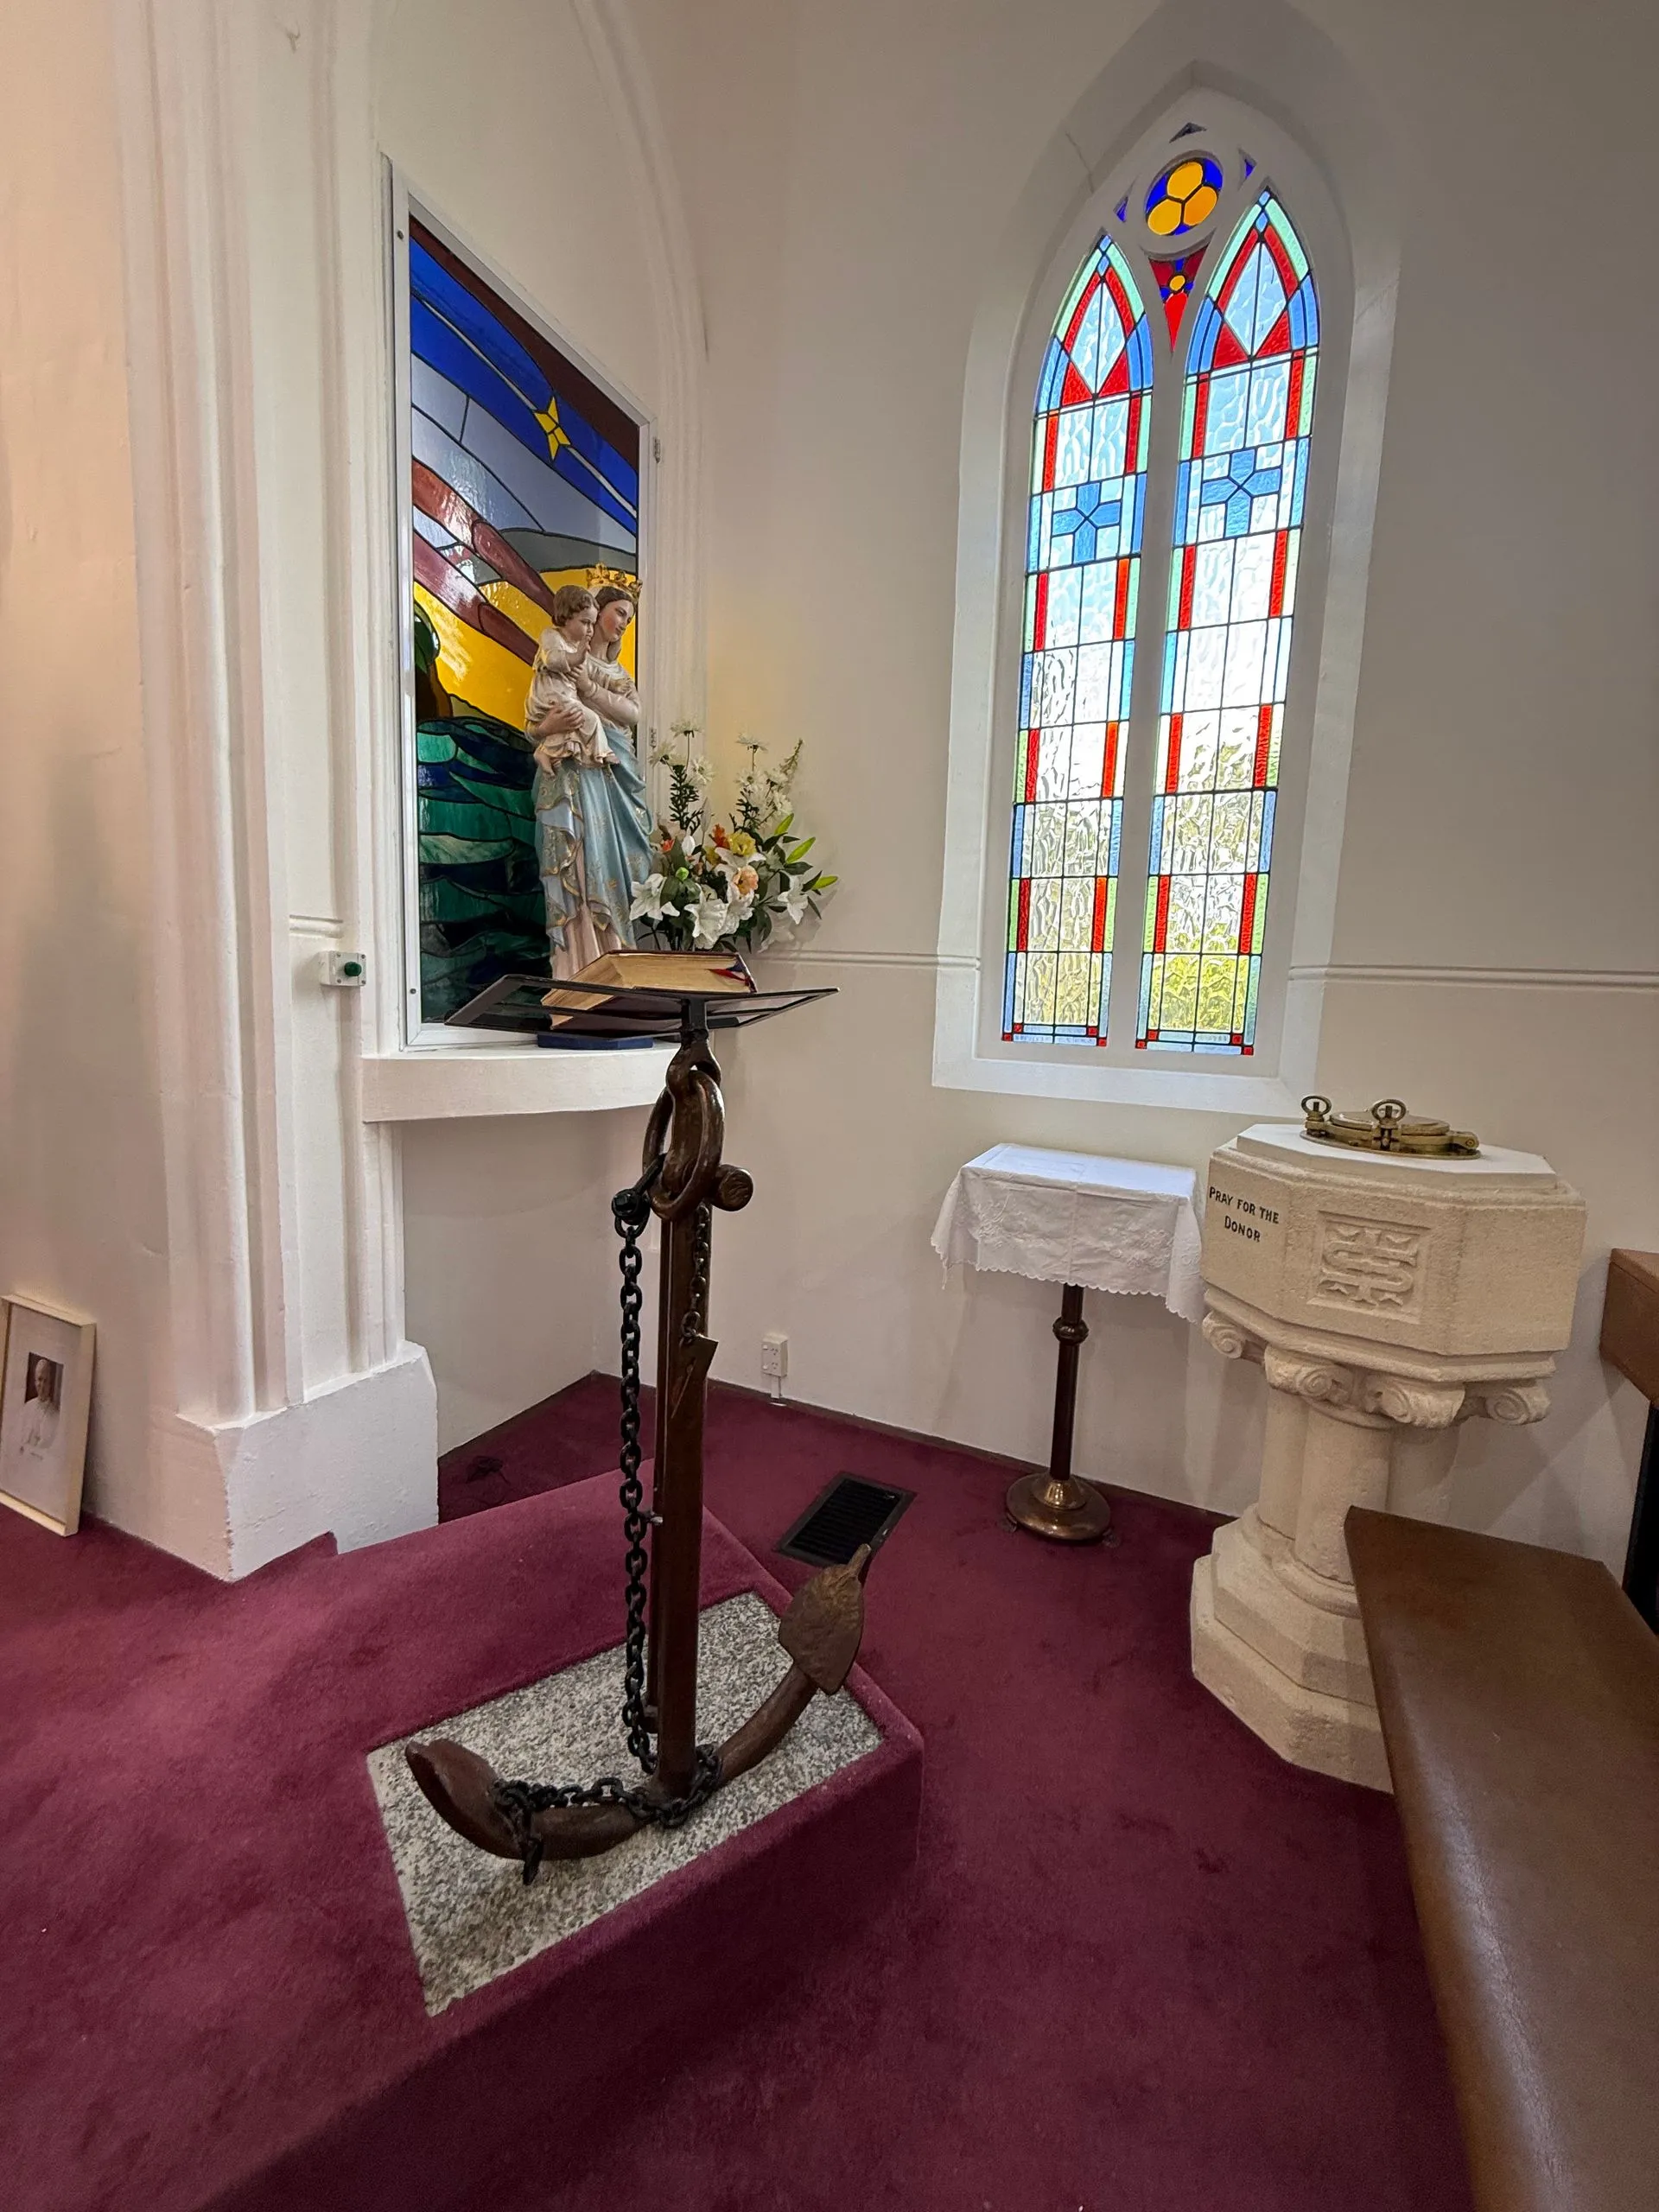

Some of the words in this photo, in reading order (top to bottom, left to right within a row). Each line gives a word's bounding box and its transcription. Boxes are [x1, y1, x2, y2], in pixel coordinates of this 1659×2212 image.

[1209, 1186, 1233, 1205] PRAY
[1237, 1198, 1255, 1216] FOR
[1259, 1206, 1279, 1224] THE
[1224, 1216, 1261, 1243] DONOR
